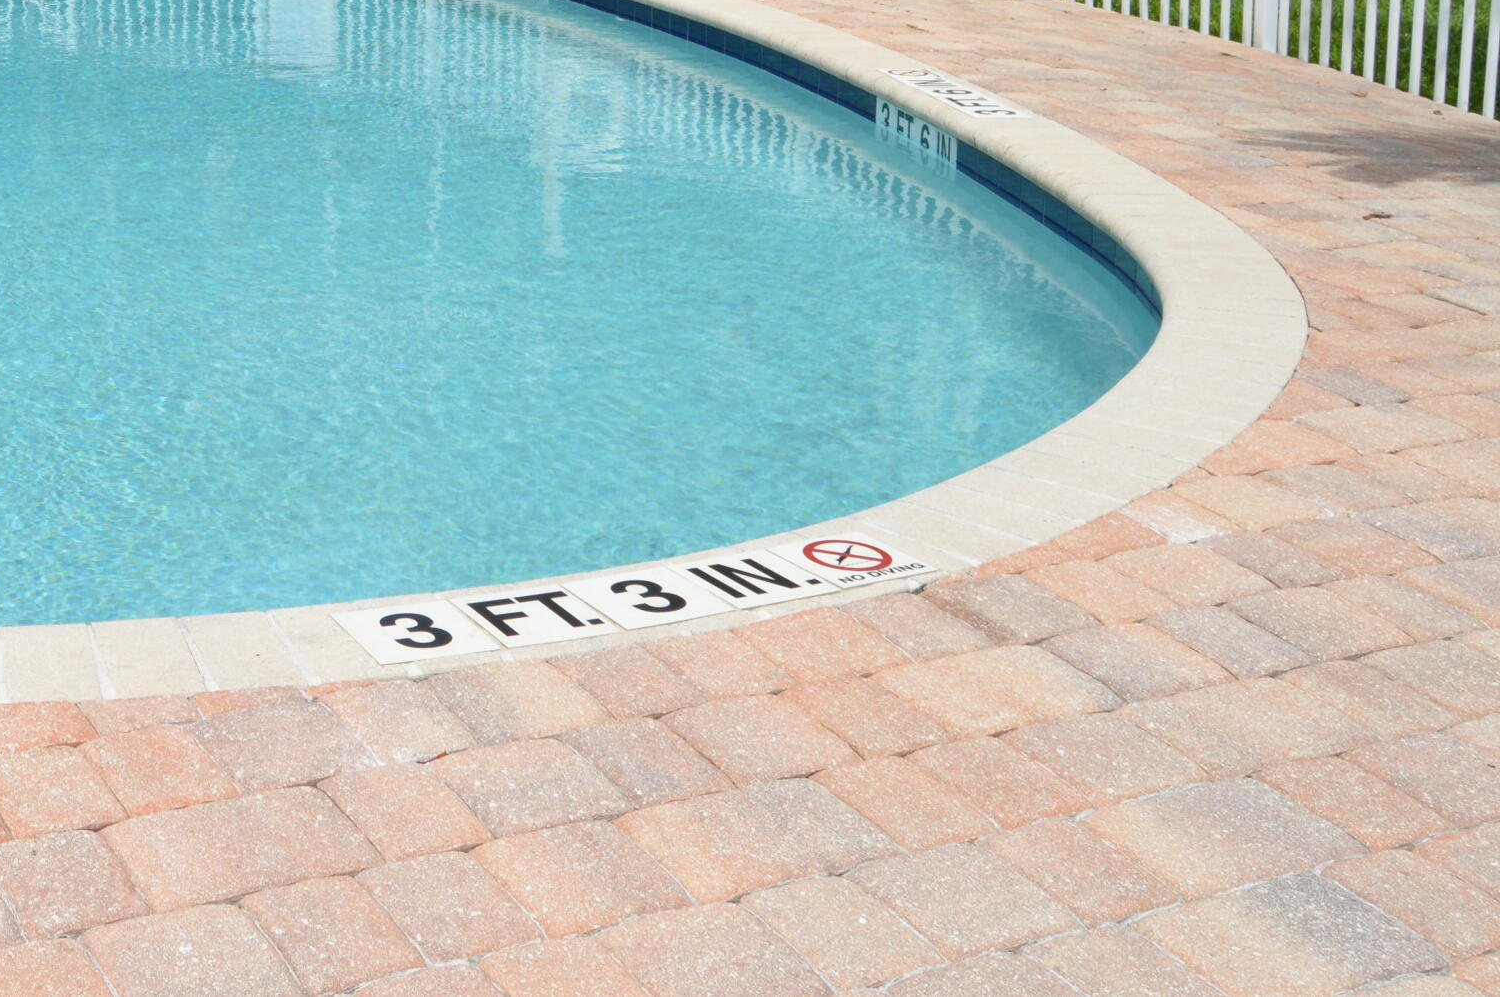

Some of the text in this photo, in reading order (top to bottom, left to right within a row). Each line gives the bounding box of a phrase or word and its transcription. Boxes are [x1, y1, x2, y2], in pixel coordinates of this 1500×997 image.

[881, 102, 952, 163] 3 FT 6 IN
[837, 561, 926, 584] NO DIVING
[379, 558, 823, 649] 3 FT. 3 IN.
